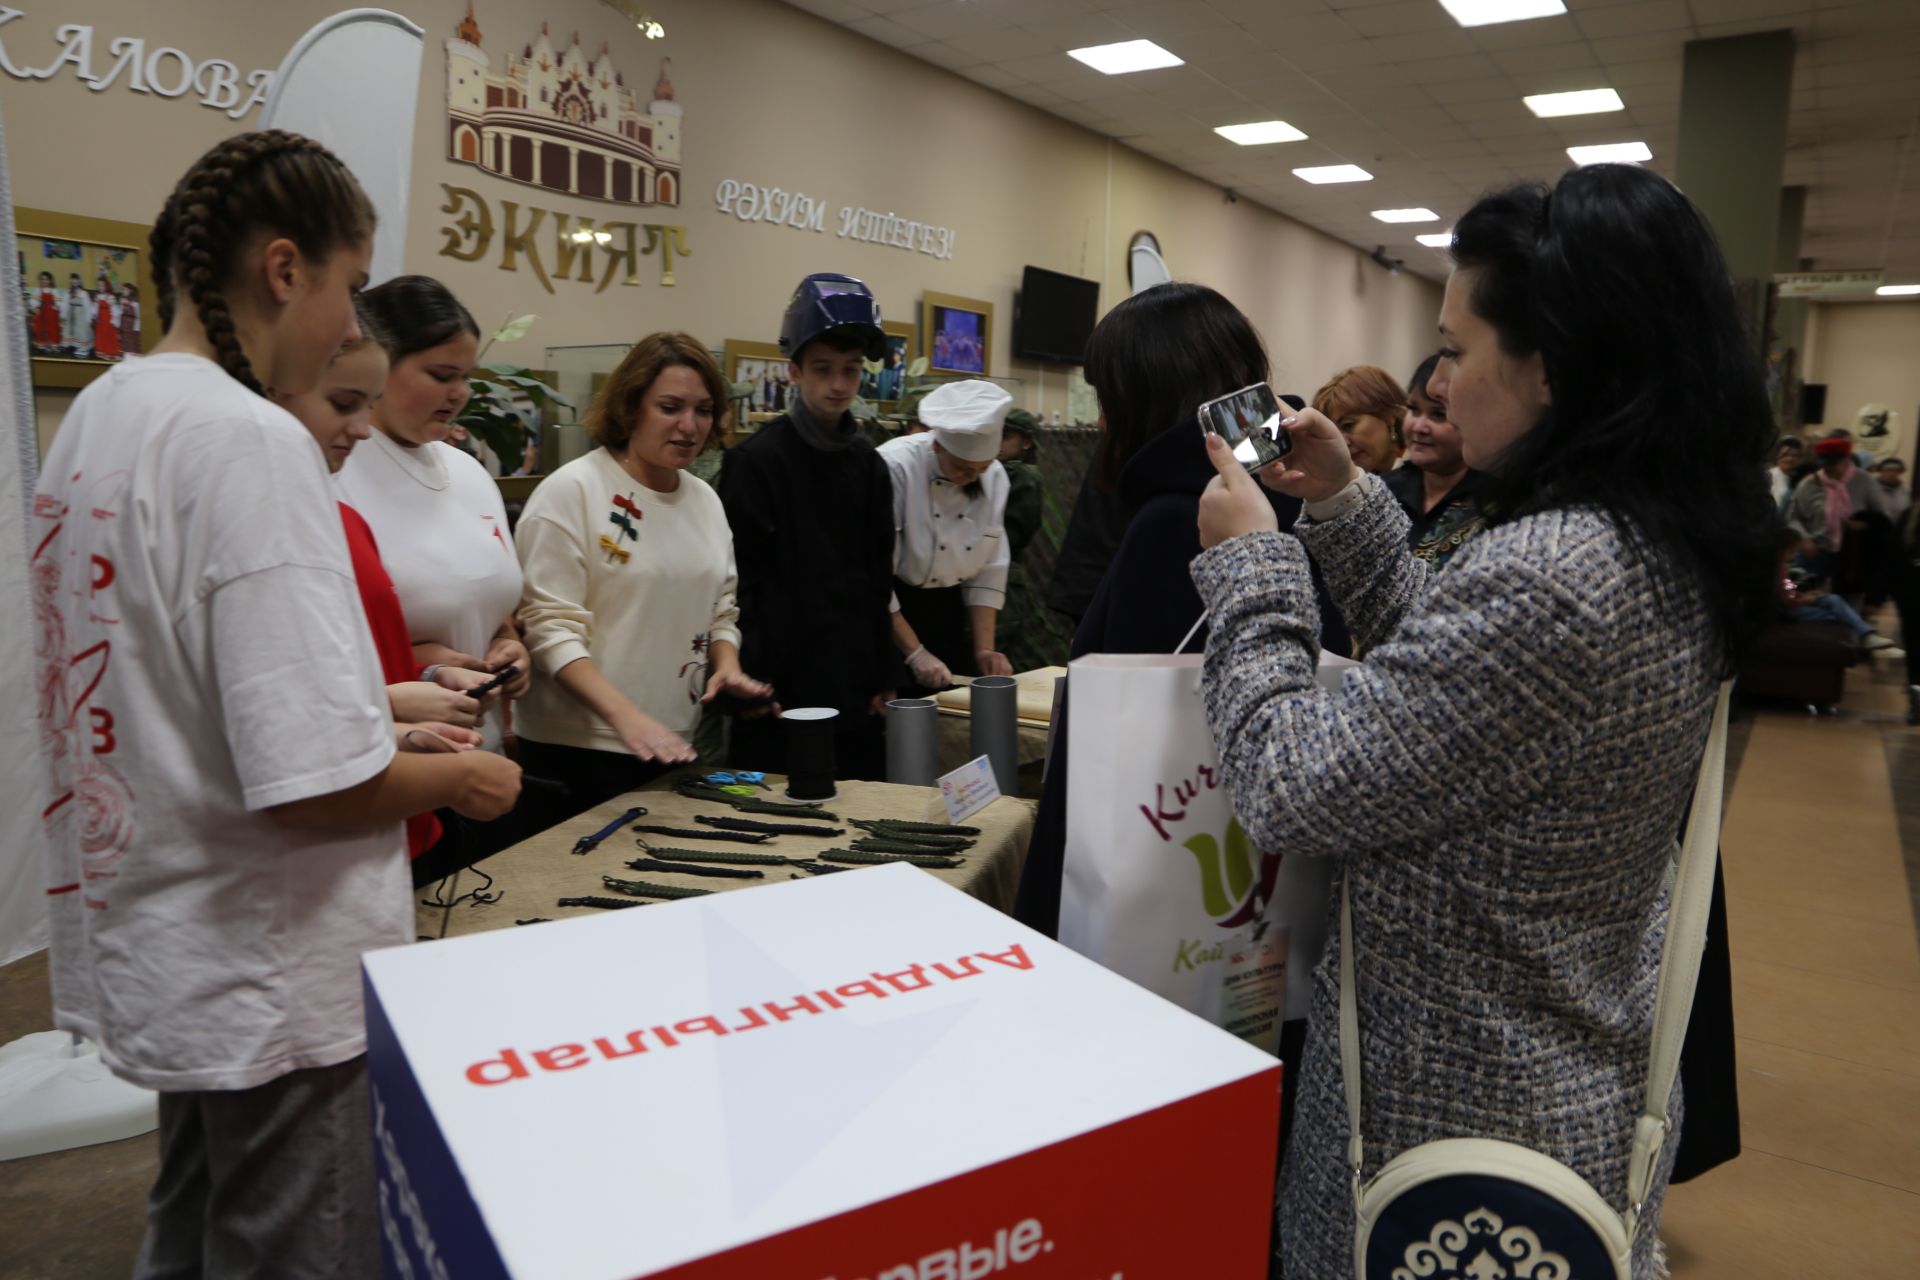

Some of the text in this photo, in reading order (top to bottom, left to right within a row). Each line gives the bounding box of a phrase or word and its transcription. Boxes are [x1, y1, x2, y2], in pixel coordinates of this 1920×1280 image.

[715, 179, 827, 233] РӘХИМ
[1172, 938, 1226, 974] Кай
[464, 942, 1036, 1087] Алдынгылар
